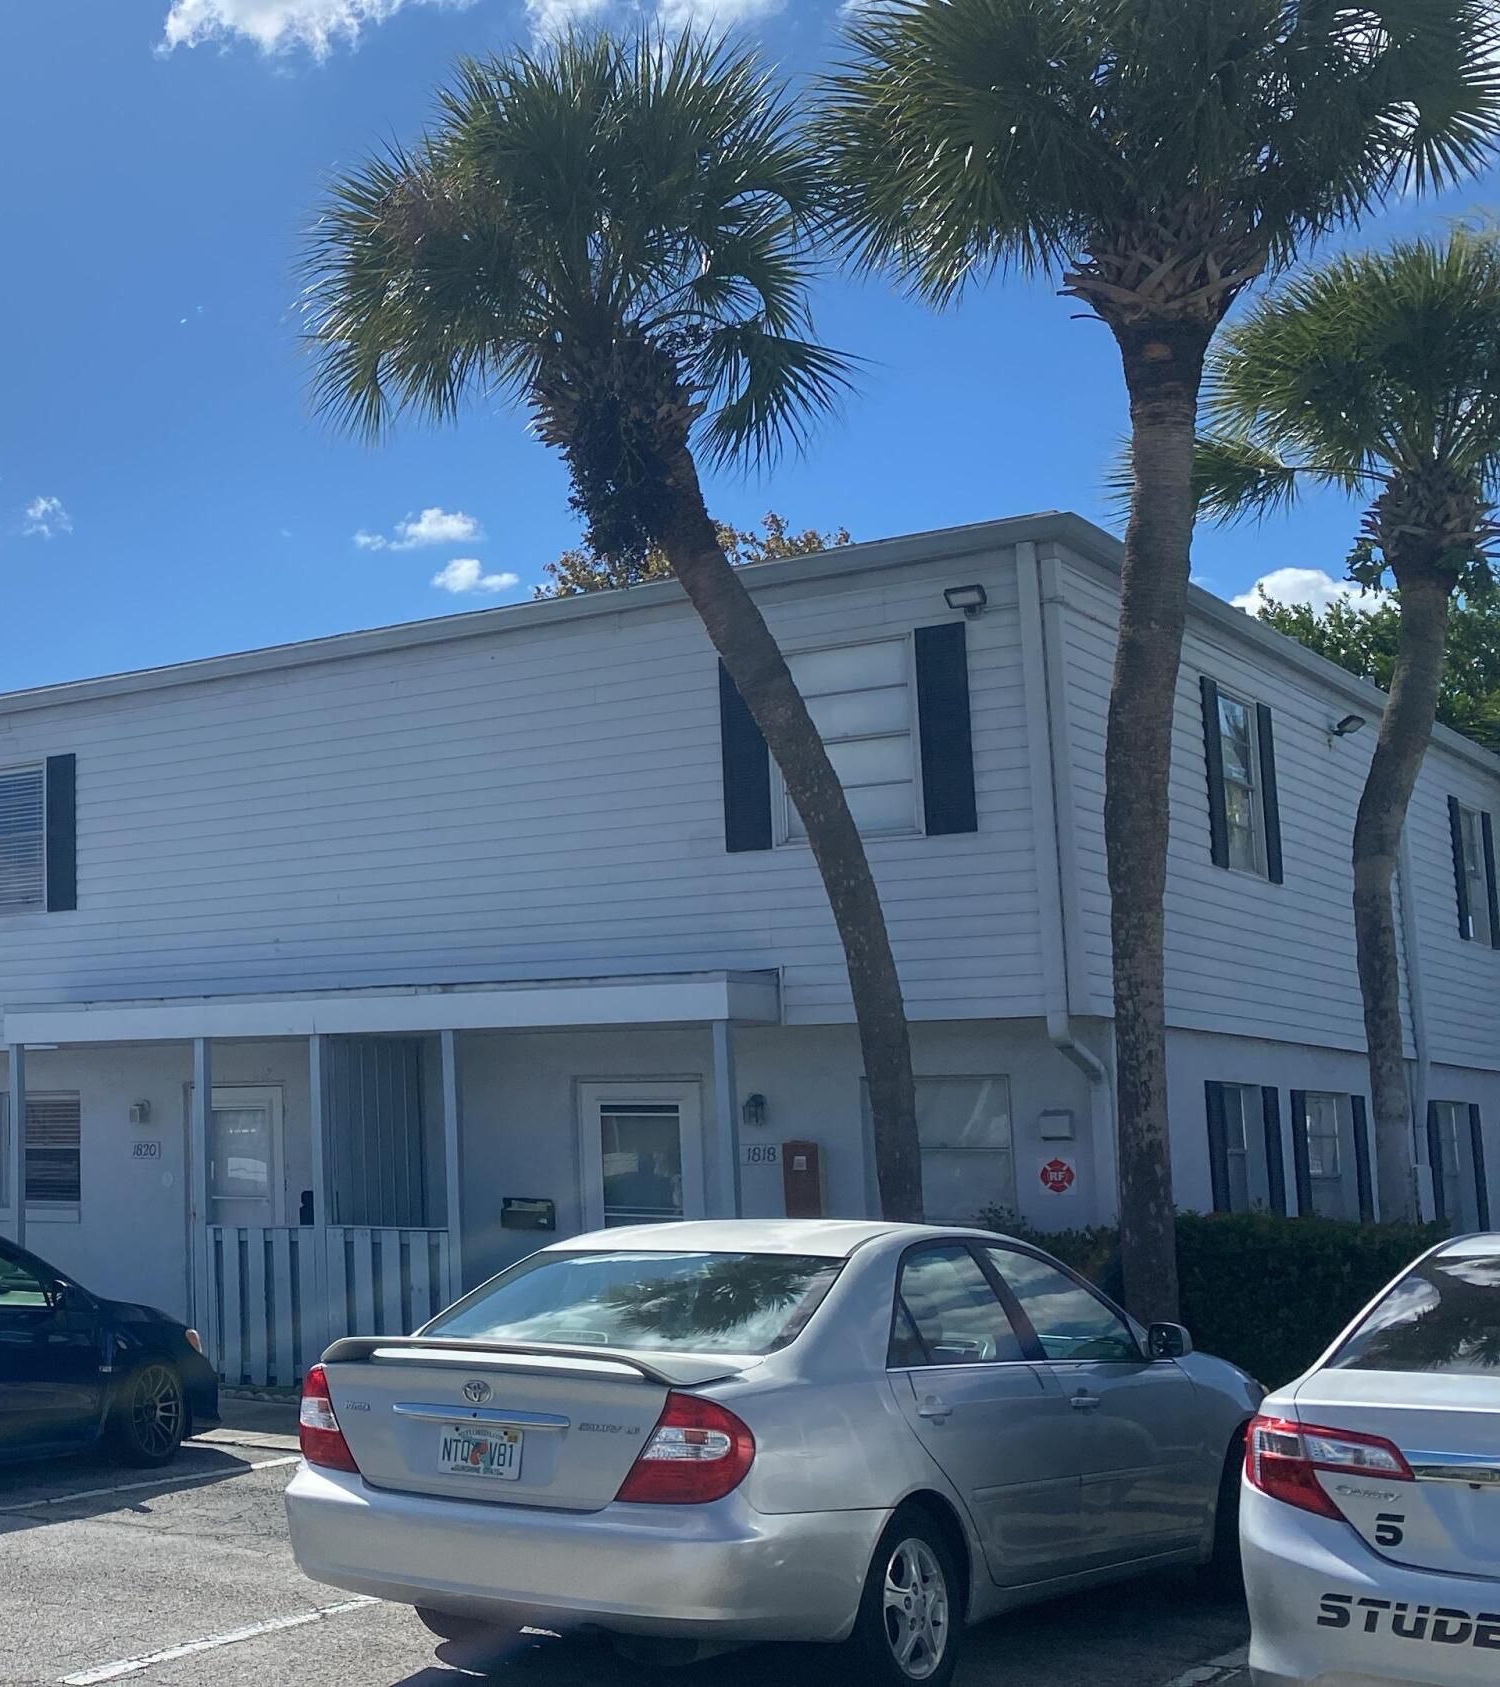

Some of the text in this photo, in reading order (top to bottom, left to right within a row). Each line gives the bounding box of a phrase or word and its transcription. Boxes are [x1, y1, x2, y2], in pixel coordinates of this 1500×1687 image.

[132, 1143, 157, 1157] 1820
[747, 1146, 777, 1163] 1818
[1049, 1171, 1066, 1182] RF
[442, 1438, 470, 1463] NTQ
[1375, 1513, 1405, 1546] 5
[1316, 1593, 1500, 1650] STUDE
